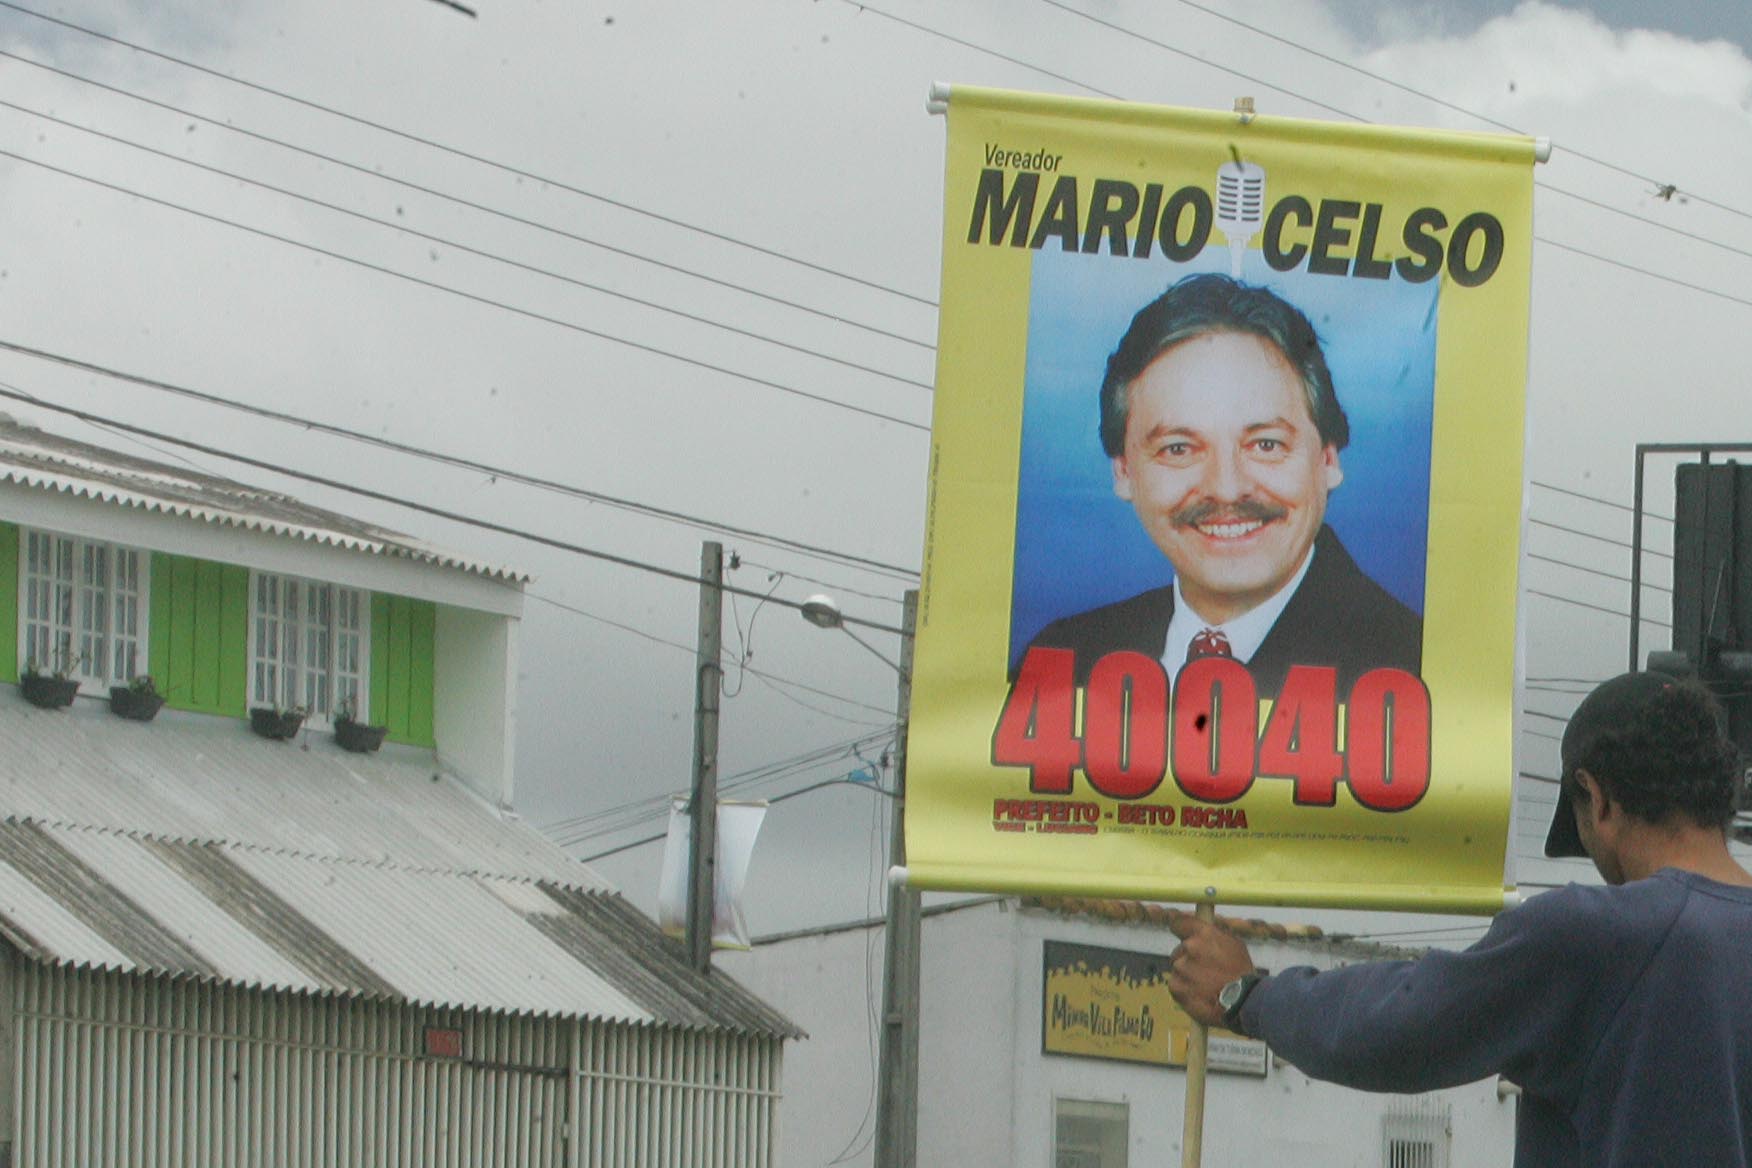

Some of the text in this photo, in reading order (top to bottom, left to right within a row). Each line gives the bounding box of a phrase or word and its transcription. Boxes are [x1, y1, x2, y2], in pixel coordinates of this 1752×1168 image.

[984, 143, 1063, 173] Vereador
[968, 169, 1505, 288] MARIO CELSO
[992, 646, 1432, 813] 40040
[994, 800, 1100, 822] PREFEITO
[1118, 804, 1175, 826] BETO
[1180, 807, 1248, 829] RICHA
